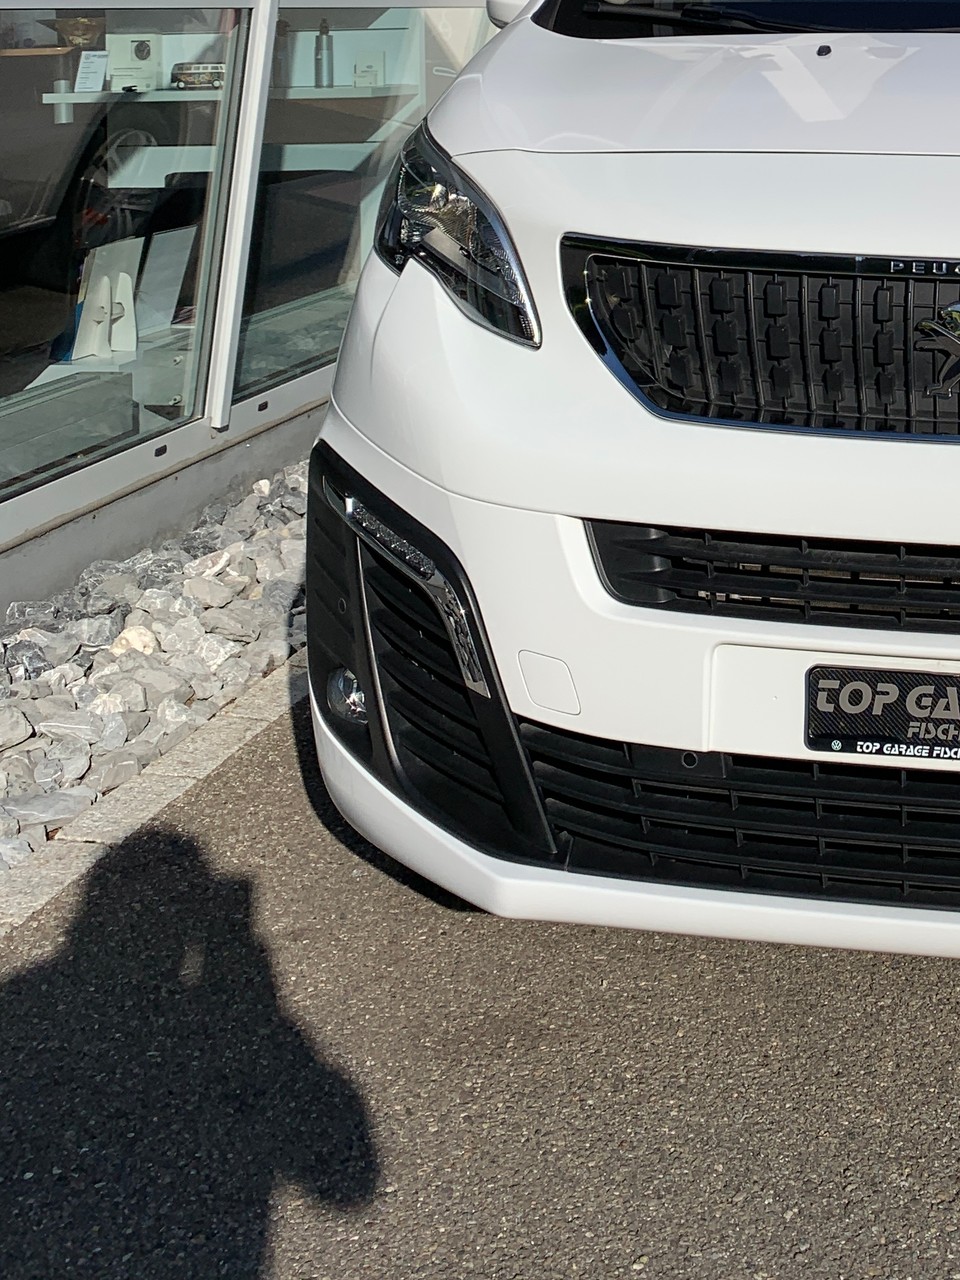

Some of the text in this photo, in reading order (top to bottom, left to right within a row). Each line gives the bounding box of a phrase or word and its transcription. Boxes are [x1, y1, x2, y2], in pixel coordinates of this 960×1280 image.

[816, 679, 899, 715] TOP
[856, 741, 880, 753] TOP
[883, 743, 930, 757] GARAGE
